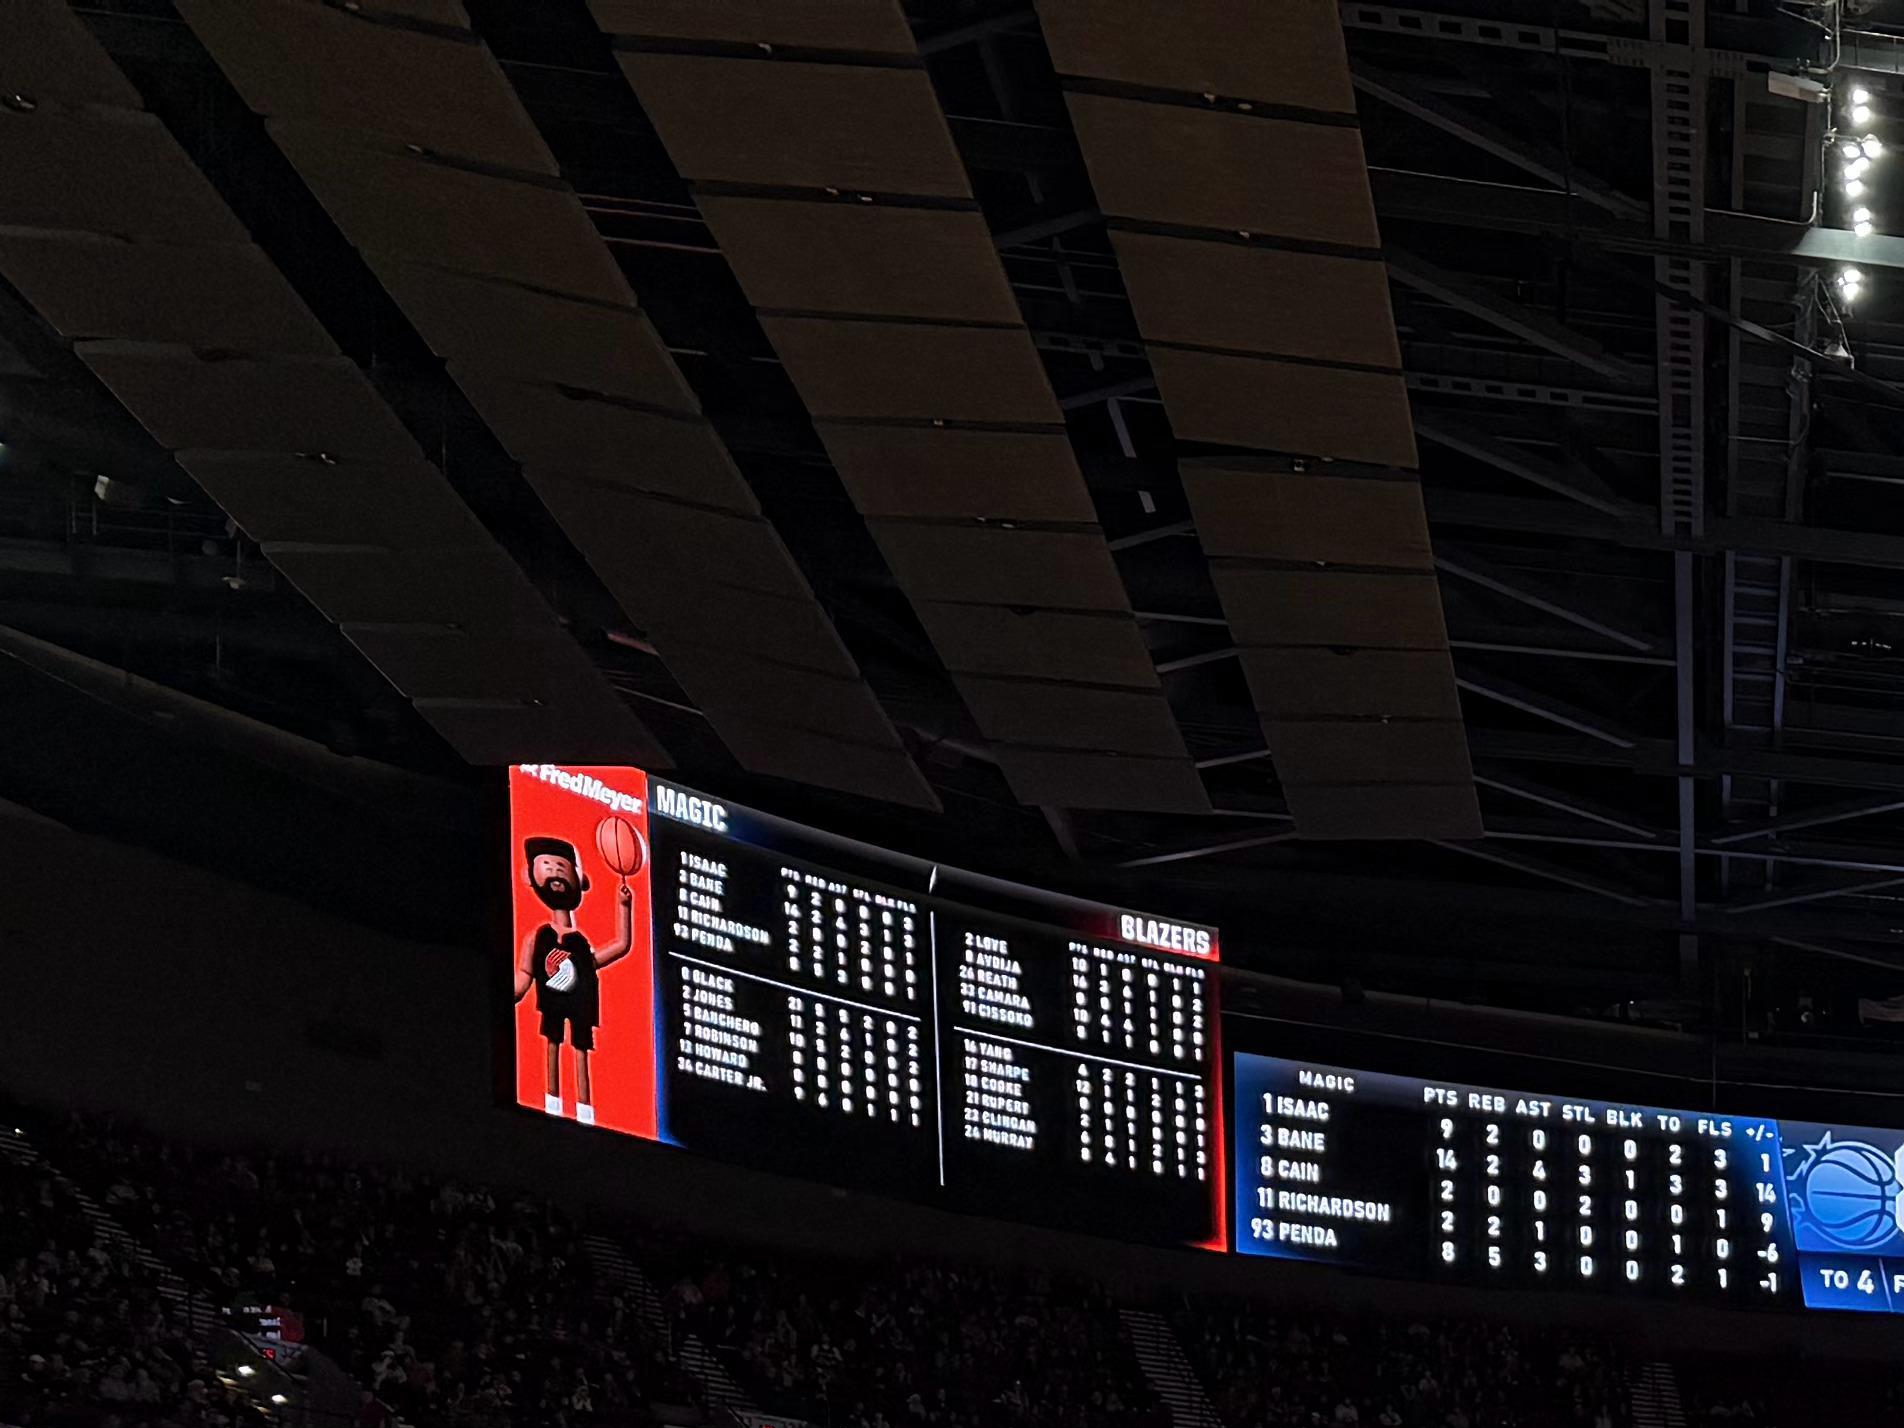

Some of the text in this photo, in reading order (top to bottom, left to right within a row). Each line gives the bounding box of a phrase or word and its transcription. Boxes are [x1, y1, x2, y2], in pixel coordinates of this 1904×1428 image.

[656, 785, 728, 832] MAGIC
[1121, 914, 1210, 954] BLAZERS
[1299, 1070, 1354, 1093] MAGIC
[1262, 1093, 1329, 1121] 1 ISAAC
[1423, 1086, 1732, 1137] PTS REB AST STL BLK TO FLS
[1260, 1124, 1325, 1152] 3 BANE
[1260, 1155, 1320, 1183] 8 CAIN
[1257, 1187, 1391, 1222] 11 RICHARDSON
[1251, 1218, 1338, 1247] 93 PENDA
[1820, 1269, 1875, 1294] TO 4
